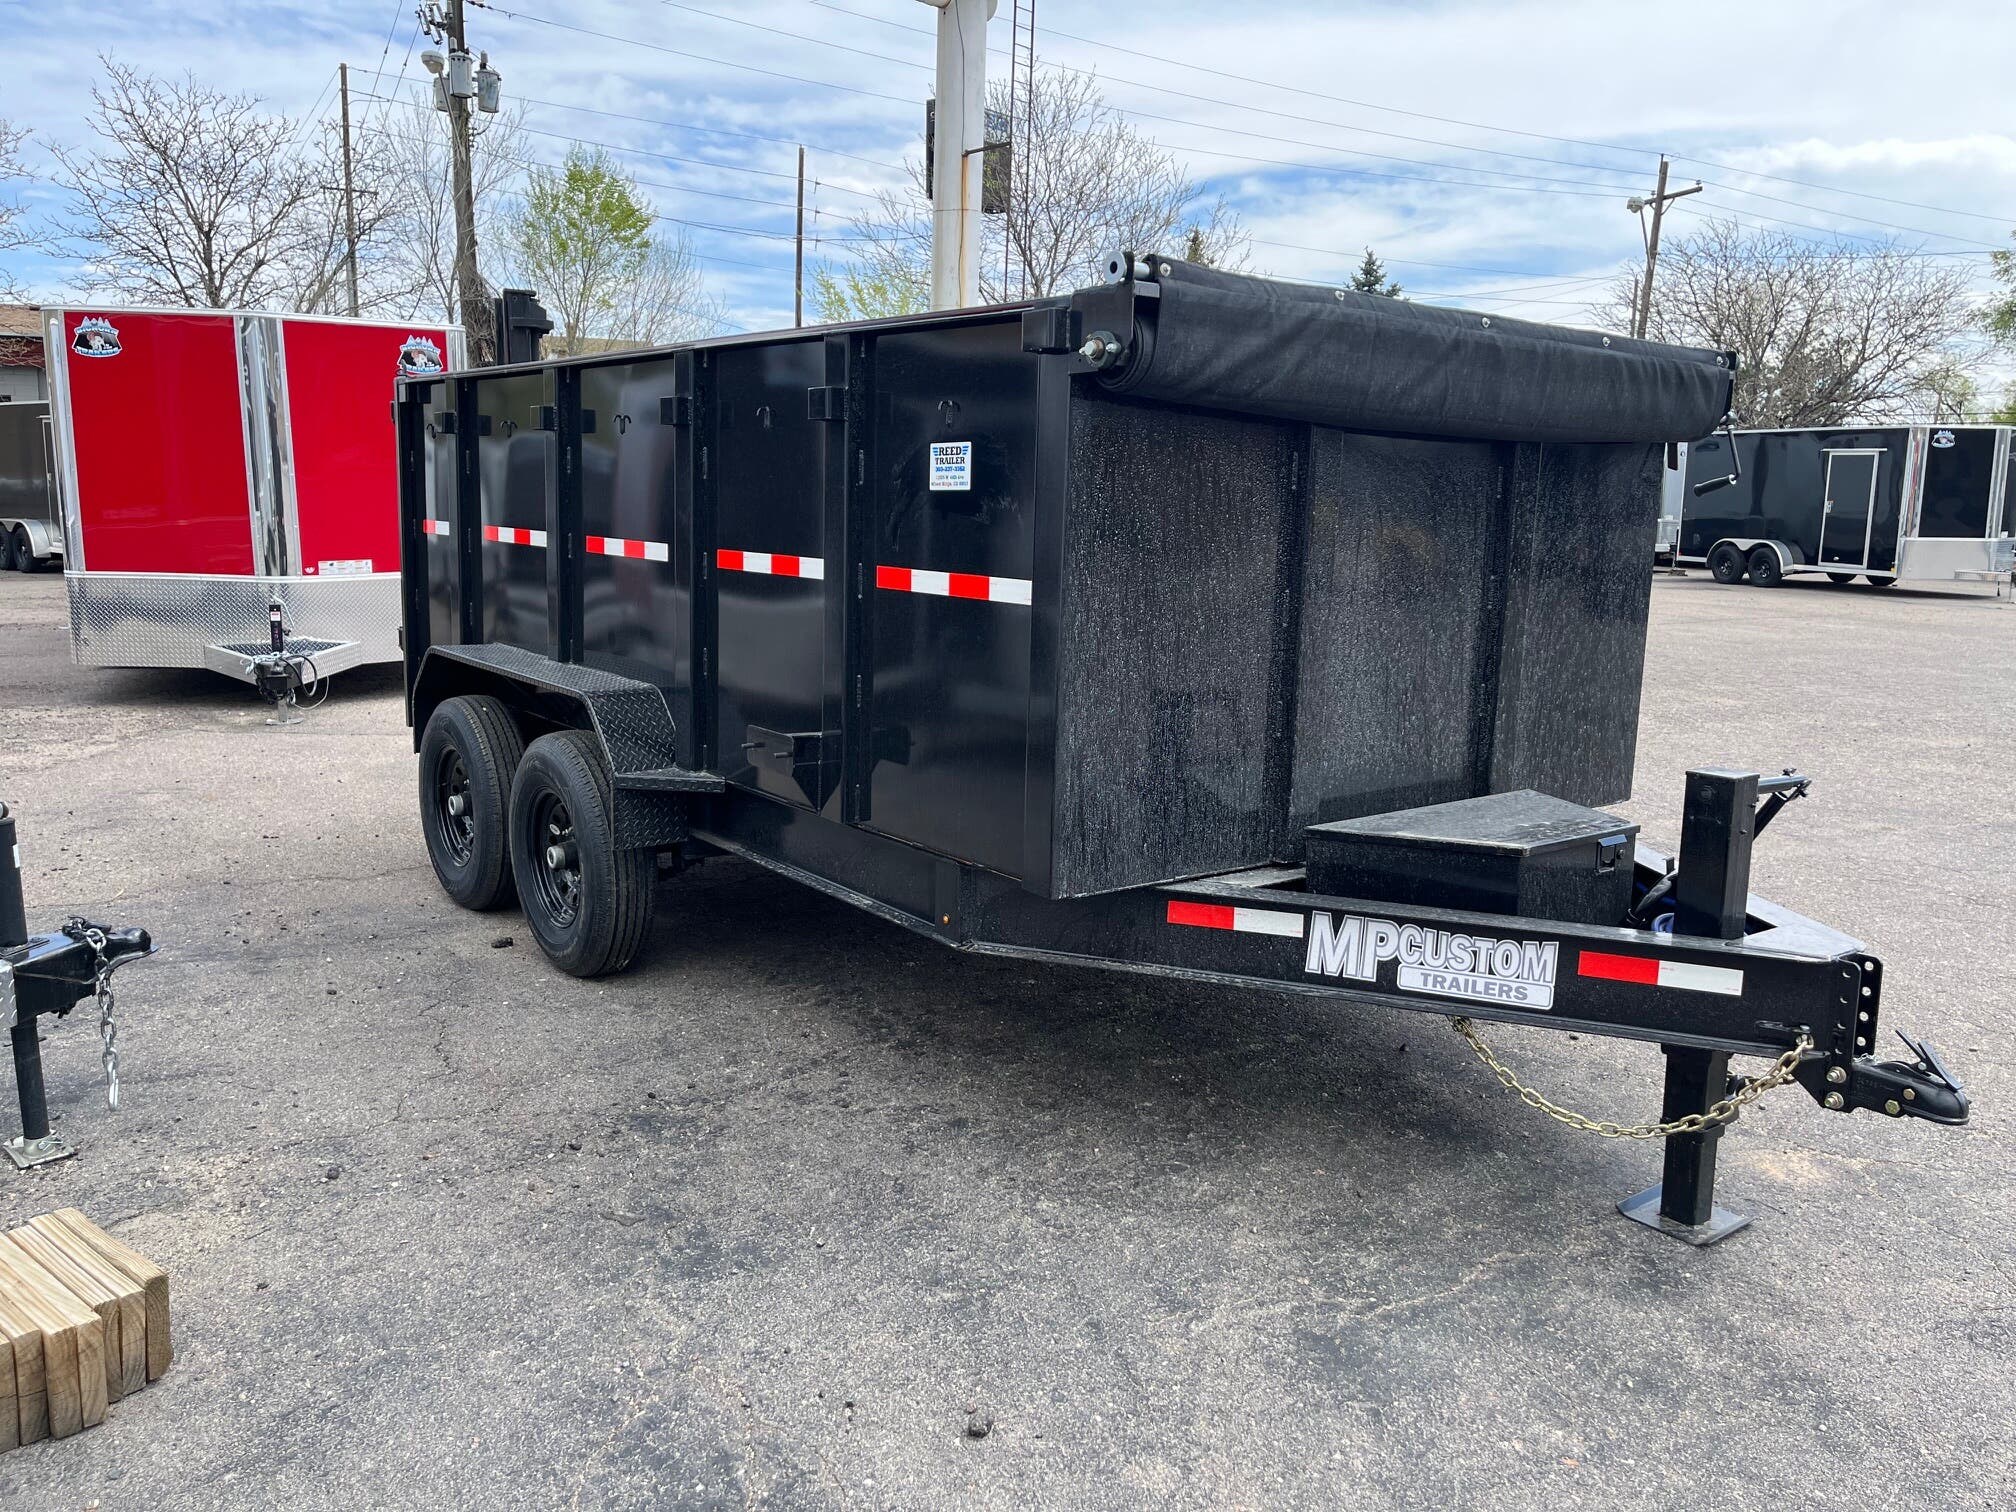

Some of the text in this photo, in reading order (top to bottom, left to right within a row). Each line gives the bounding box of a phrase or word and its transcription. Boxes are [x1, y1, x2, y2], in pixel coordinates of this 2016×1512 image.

[938, 446, 962, 456] REED
[935, 457, 966, 465] TRAILER
[1305, 911, 1559, 985] MP CUSTOM
[1420, 972, 1528, 1001] TRAILERS
